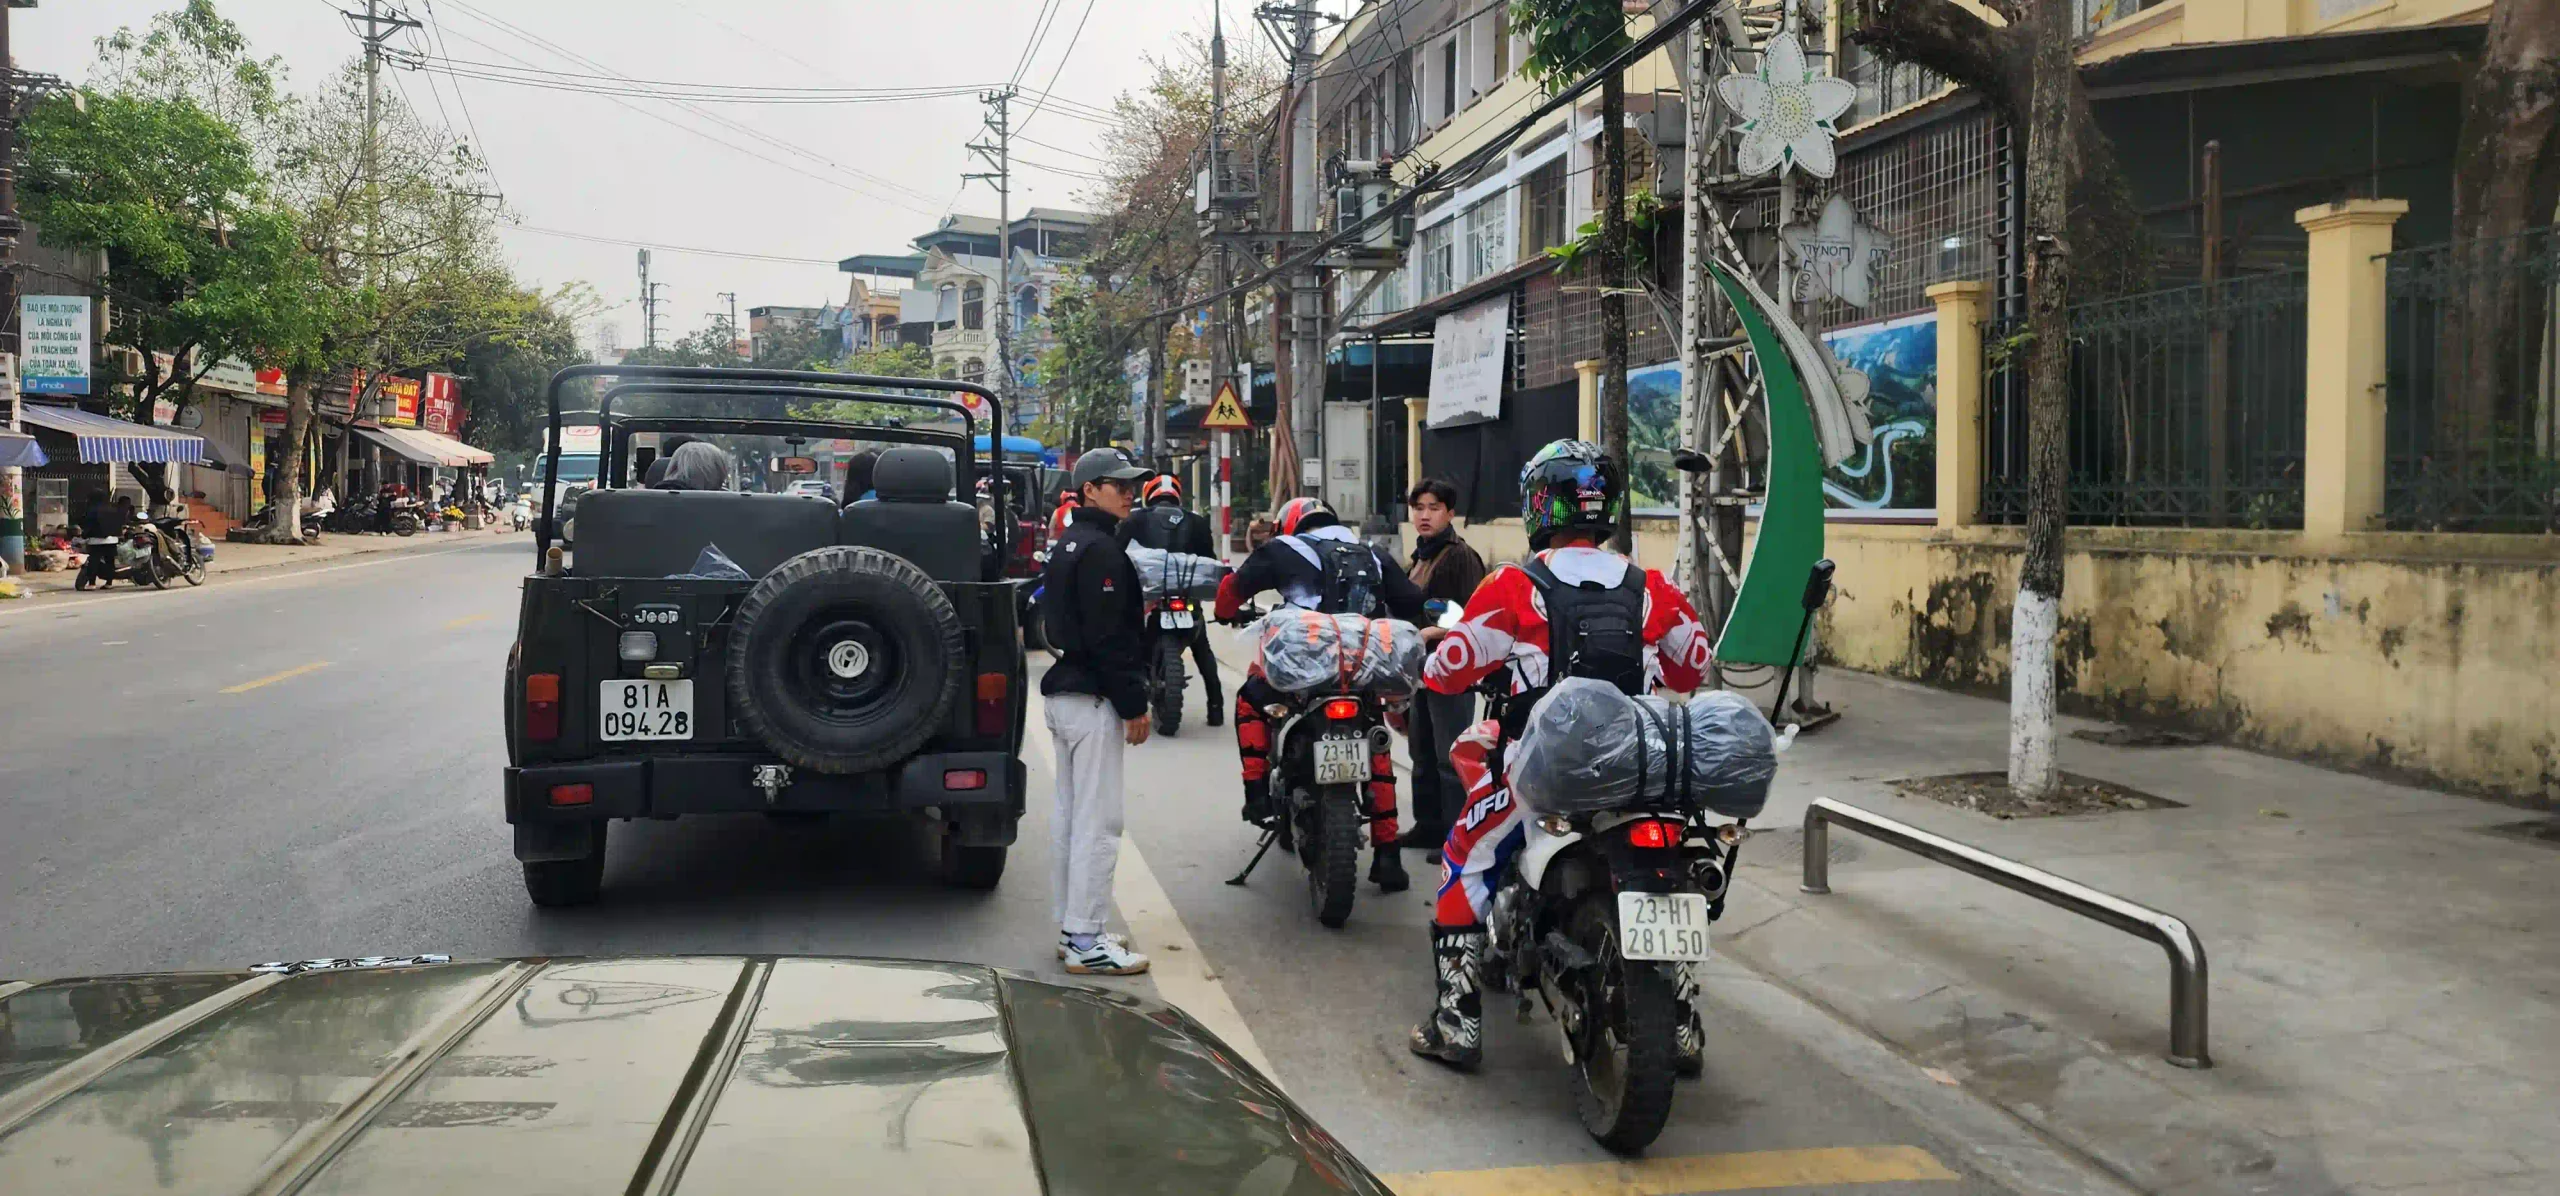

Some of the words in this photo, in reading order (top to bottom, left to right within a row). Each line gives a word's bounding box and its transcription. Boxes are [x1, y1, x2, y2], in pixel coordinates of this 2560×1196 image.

[634, 610, 679, 624] Jeep
[605, 711, 688, 736] 094.28
[1323, 743, 1360, 762] 23-H1
[1465, 787, 1510, 831] UFO
[1634, 898, 1691, 925] 23-H1
[1628, 927, 1703, 955] 281.50
